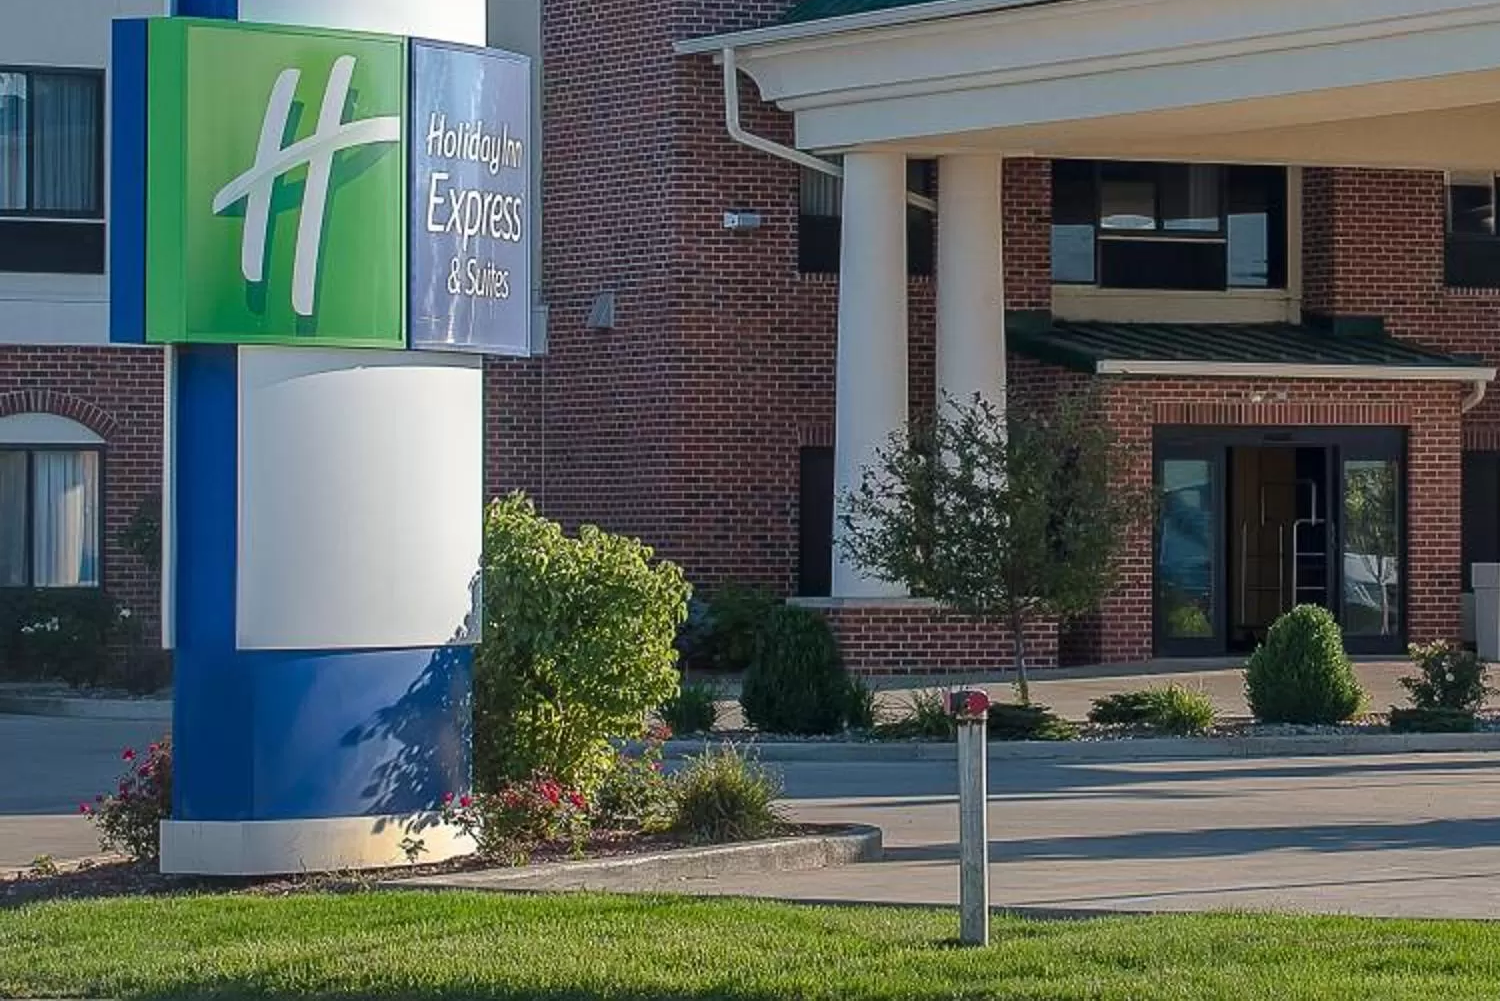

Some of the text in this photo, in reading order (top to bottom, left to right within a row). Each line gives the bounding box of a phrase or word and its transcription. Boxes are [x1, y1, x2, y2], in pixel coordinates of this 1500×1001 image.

[426, 112, 523, 174] Holiday Inn
[213, 55, 400, 316] H
[427, 173, 521, 251] Express
[447, 258, 509, 298] & Suites
